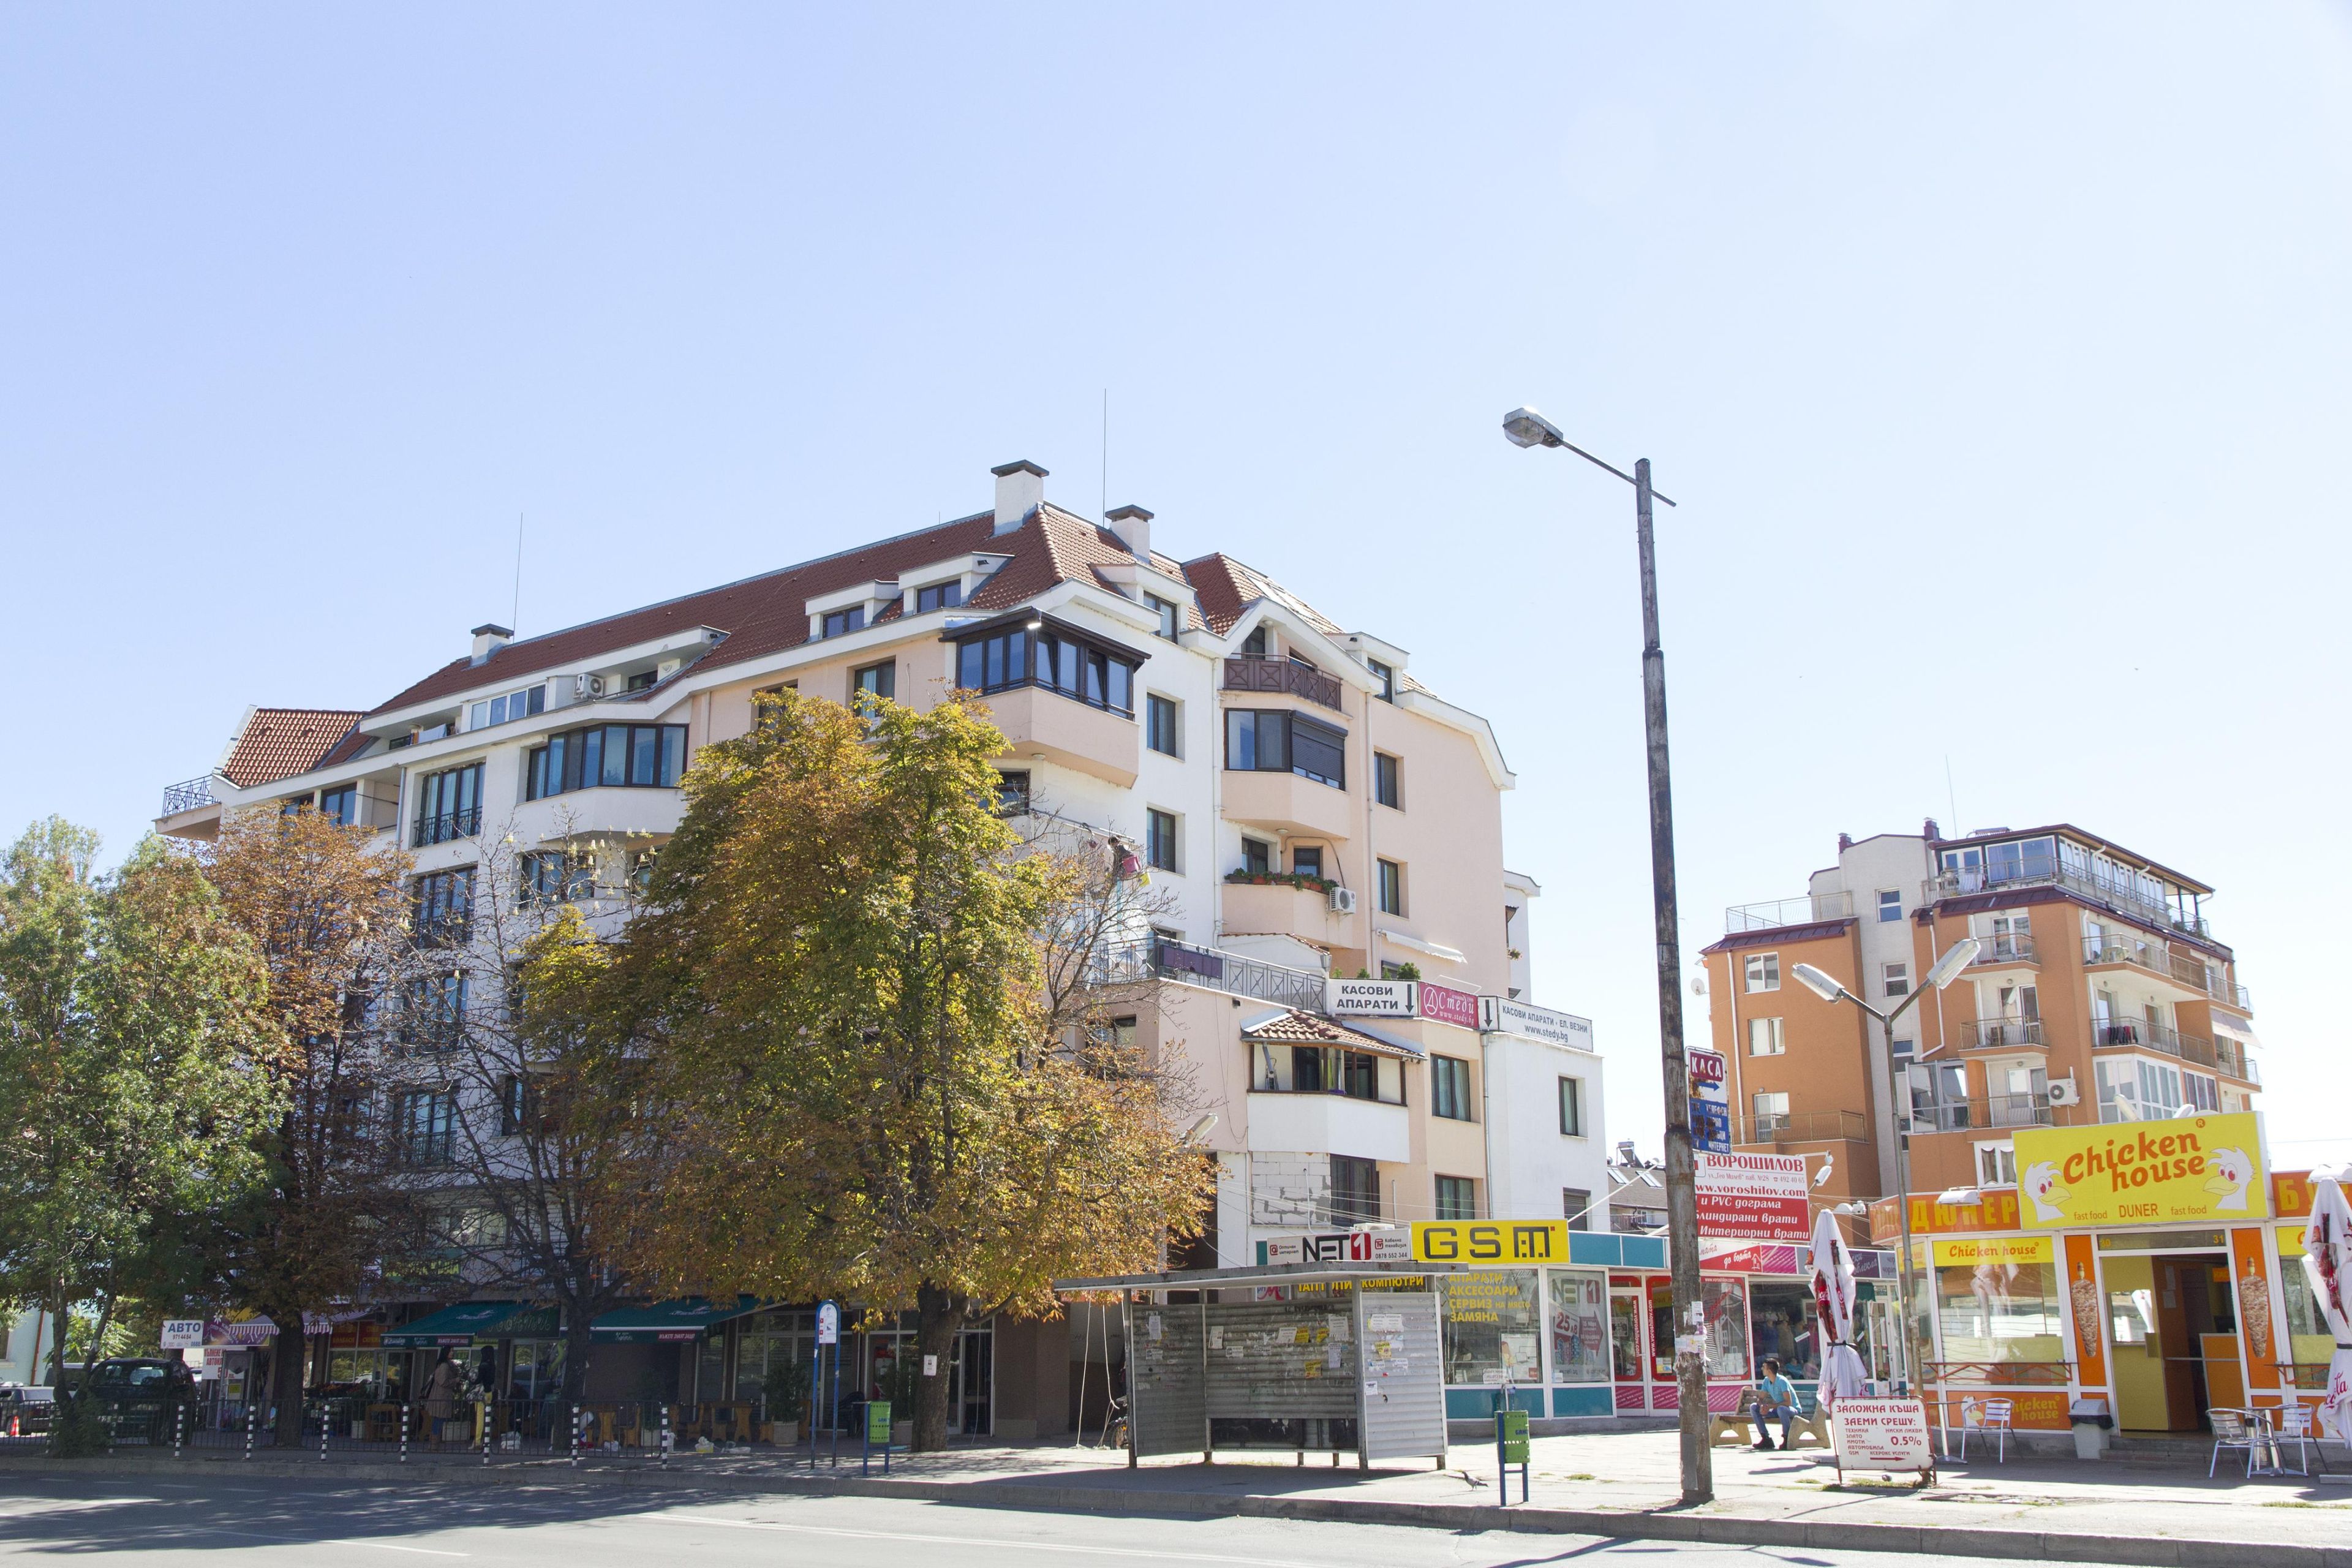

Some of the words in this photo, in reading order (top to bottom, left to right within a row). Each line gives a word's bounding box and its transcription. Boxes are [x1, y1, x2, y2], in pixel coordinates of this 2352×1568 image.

[1341, 985, 1393, 996] КАСОВИ
[1336, 999, 1398, 1009] АПАРАТИ
[1439, 992, 1474, 1014] Стеди
[1502, 1005, 1526, 1020] КАСОВИ
[1528, 1012, 1554, 1026] АПАРАТИ
[1570, 1022, 1588, 1033] ВЕЗНИ
[1525, 1025, 1569, 1042] www.stedy.bg
[1691, 1057, 1722, 1078] КАСА
[1706, 1155, 1803, 1172] ВОРОШИЛОВ
[2063, 1131, 2201, 1185] Chicken
[2112, 1155, 2205, 1193] house
[1696, 1185, 1806, 1197] ww.voroshilov.com
[1735, 1199, 1781, 1209] дограма
[2074, 1212, 2088, 1221] fast
[2090, 1210, 2108, 1219] food
[2119, 1203, 2159, 1218] DUNER
[2171, 1207, 2186, 1215] fast
[2188, 1205, 2207, 1215] food
[1762, 1213, 1798, 1224] врати
[1700, 1226, 1770, 1238] Интериорни
[1774, 1228, 1809, 1240] врати
[2213, 1235, 2225, 1243] 31
[1950, 1245, 1999, 1257] Chicken
[2003, 1245, 2037, 1256] house
[1362, 1276, 1424, 1288] КОМПЮТРИ
[1449, 1273, 1502, 1283] АПАРАТИ
[1449, 1286, 1518, 1296] АКСЕСОАРИ
[1449, 1298, 1492, 1310] СЕРВИЗ
[1450, 1311, 1499, 1322] ЗАМЯНА
[168, 1322, 201, 1333] АВТО
[1836, 1405, 1886, 1414] ЗАЛОЖНА
[2022, 1410, 2059, 1421] house
[1891, 1436, 1922, 1446] 0.5%
